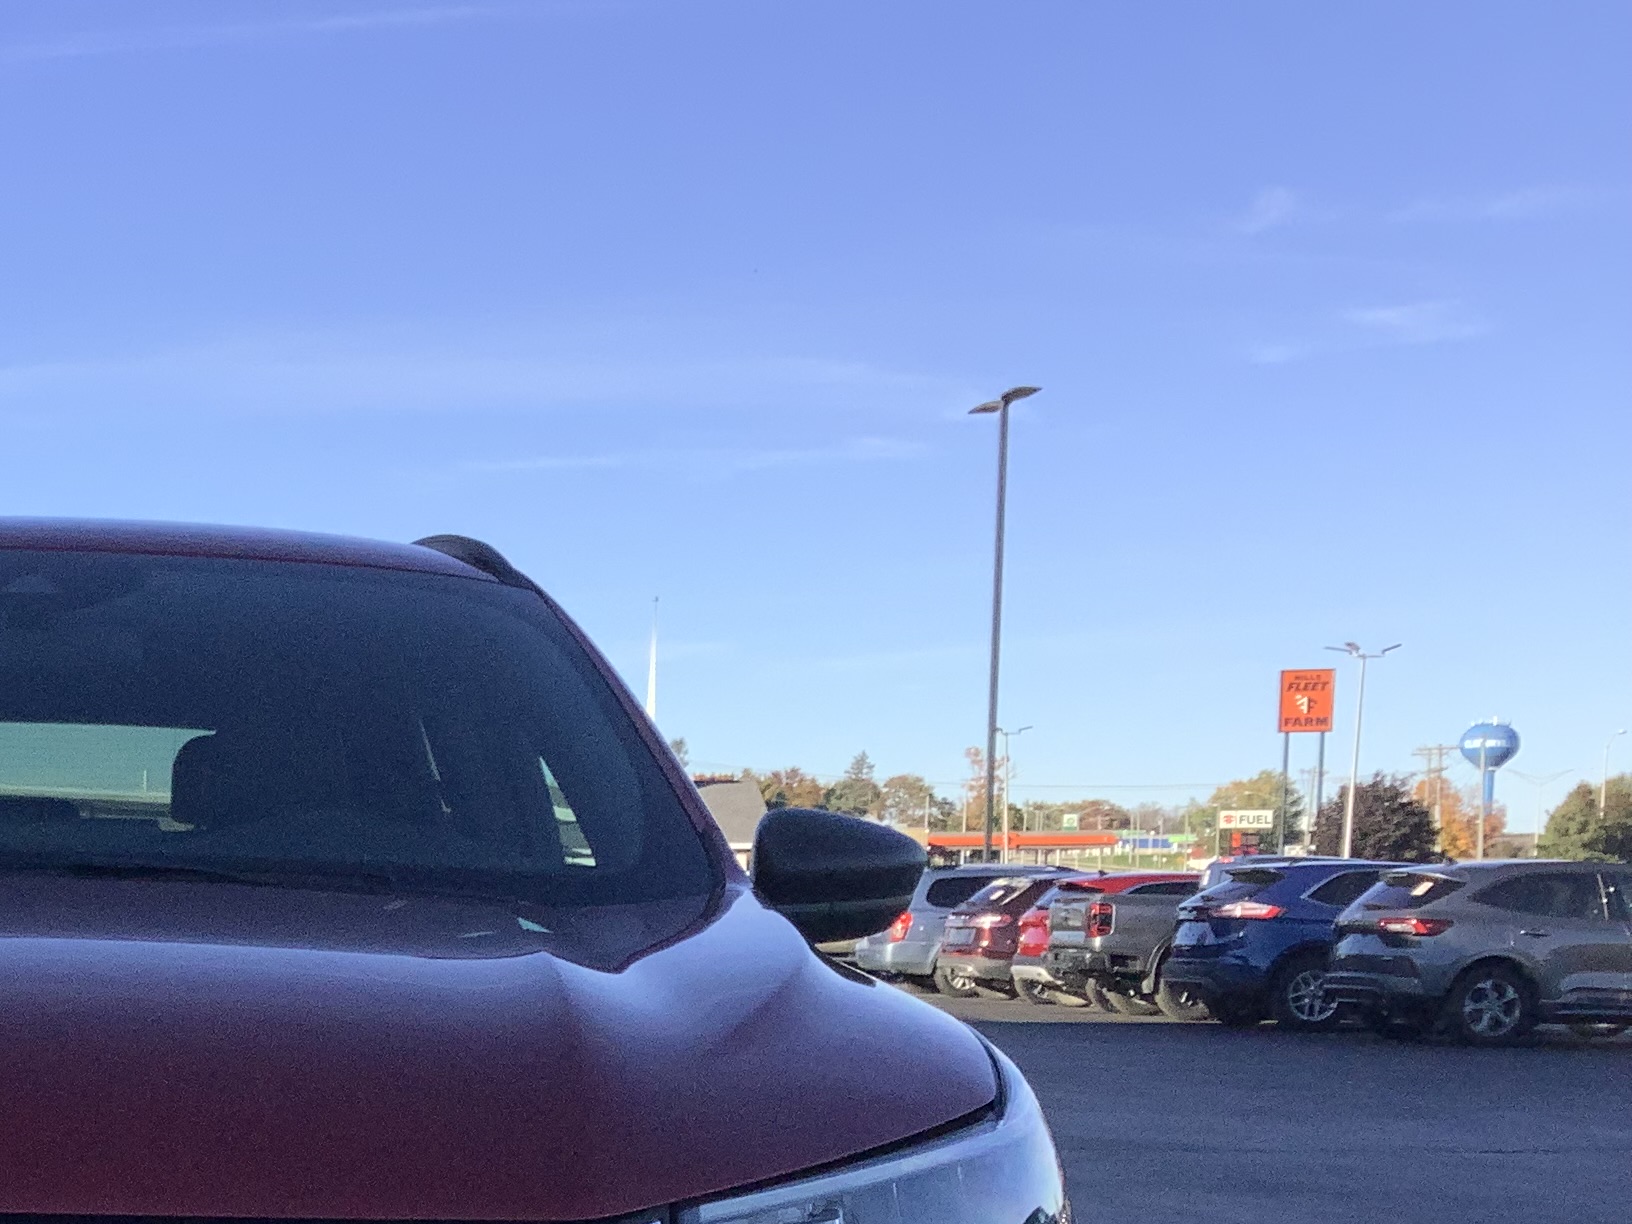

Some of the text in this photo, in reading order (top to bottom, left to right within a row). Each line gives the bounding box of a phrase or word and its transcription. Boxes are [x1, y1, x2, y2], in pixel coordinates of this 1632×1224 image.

[1286, 681, 1329, 691] FLEET
[1284, 717, 1329, 727] FARM
[1238, 814, 1272, 825] FUEL
